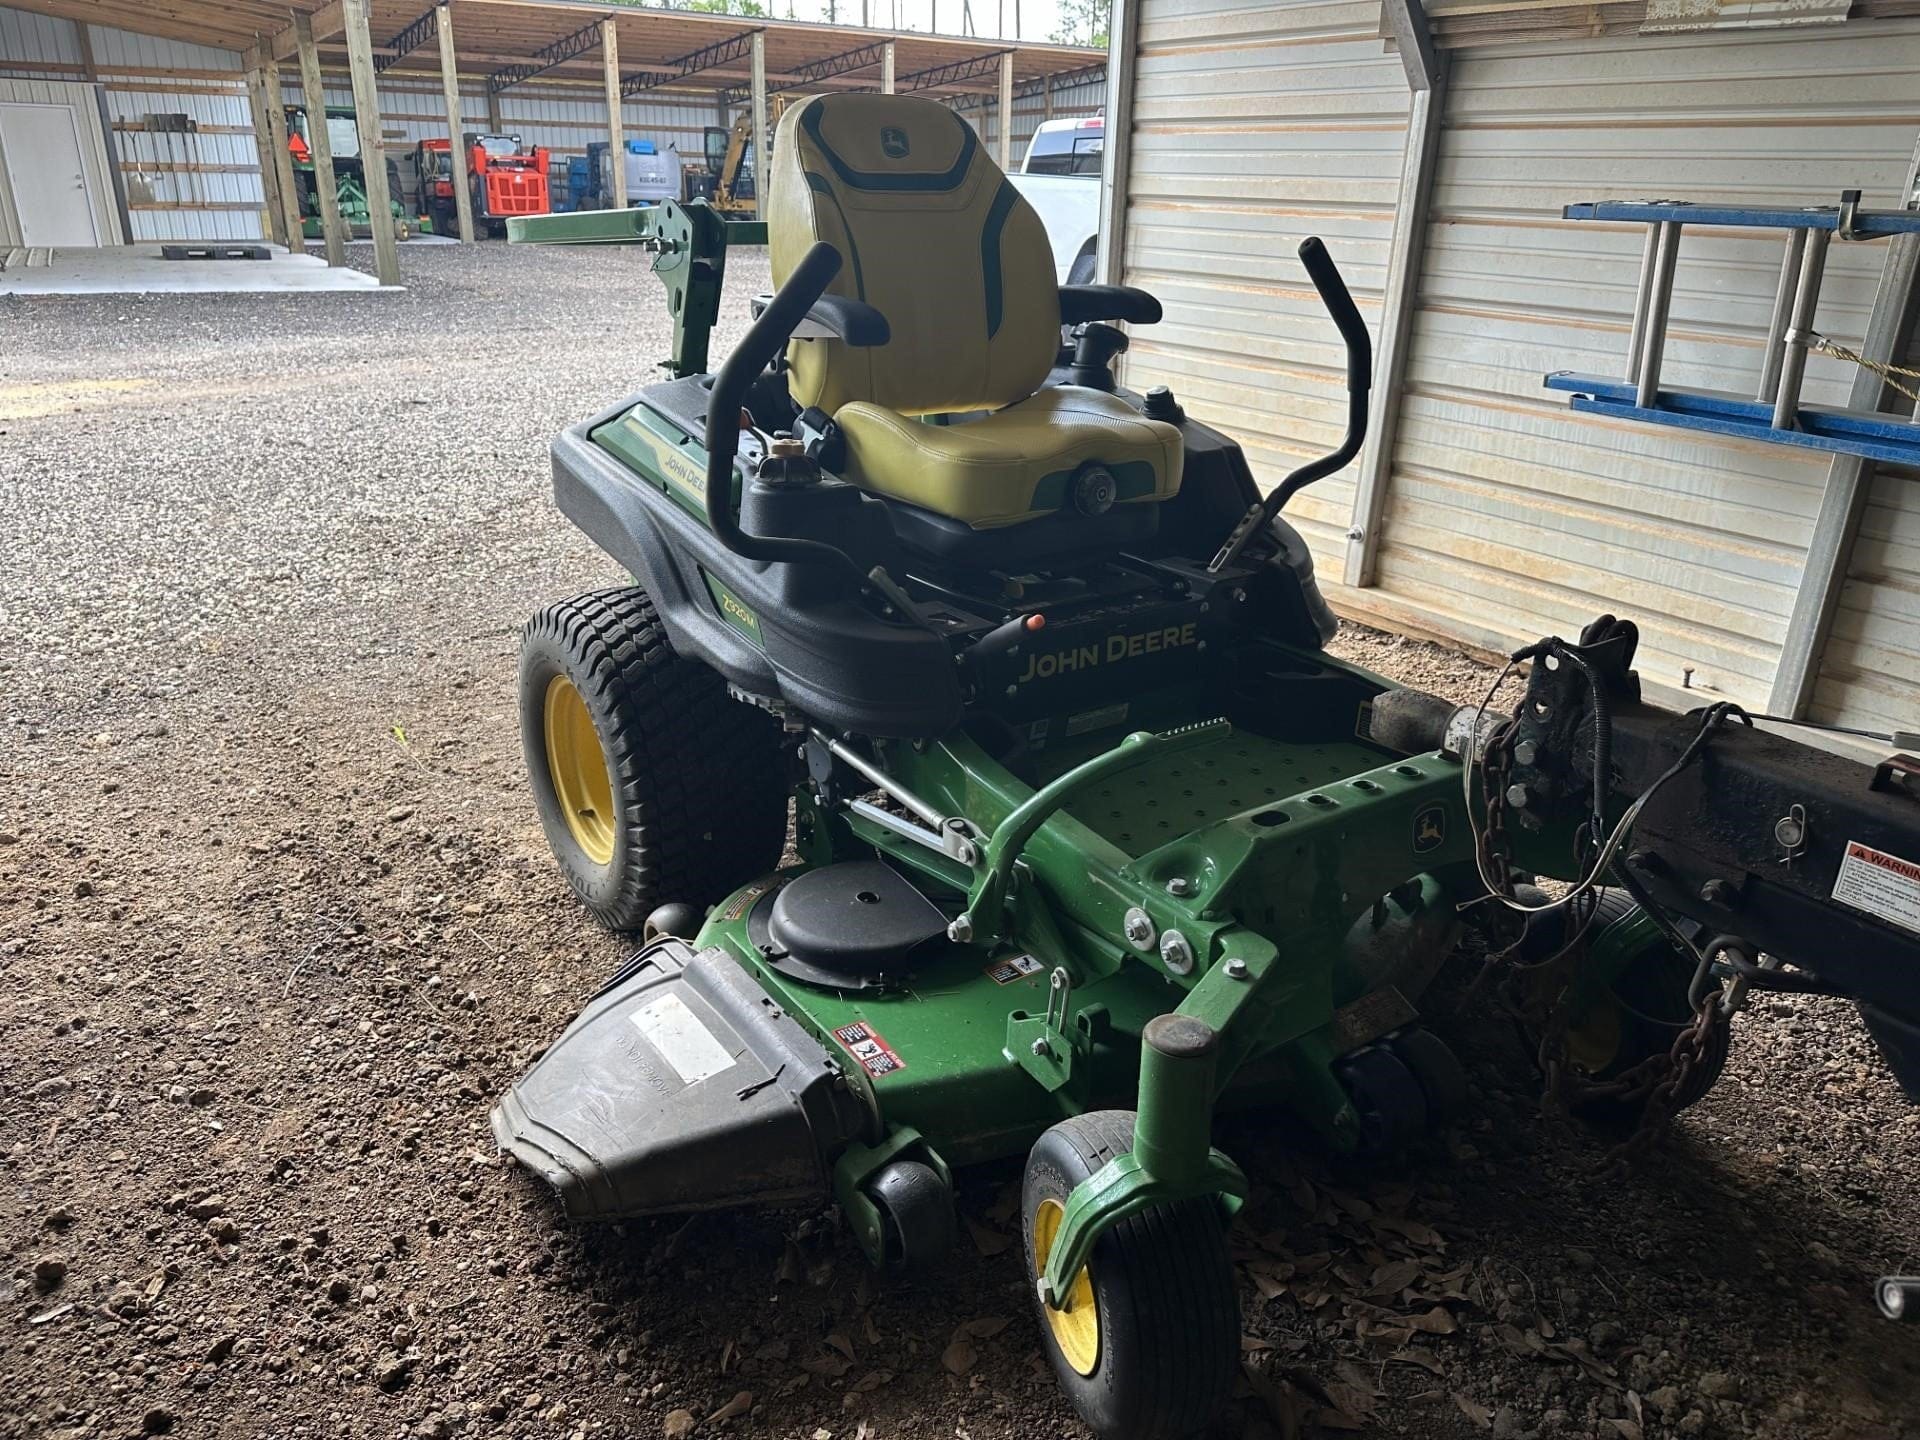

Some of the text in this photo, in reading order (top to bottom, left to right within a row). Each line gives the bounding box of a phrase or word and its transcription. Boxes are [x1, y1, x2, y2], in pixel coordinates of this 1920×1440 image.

[665, 455, 705, 492] JOHN DEE
[1018, 622, 1198, 683] JOHN DEERE
